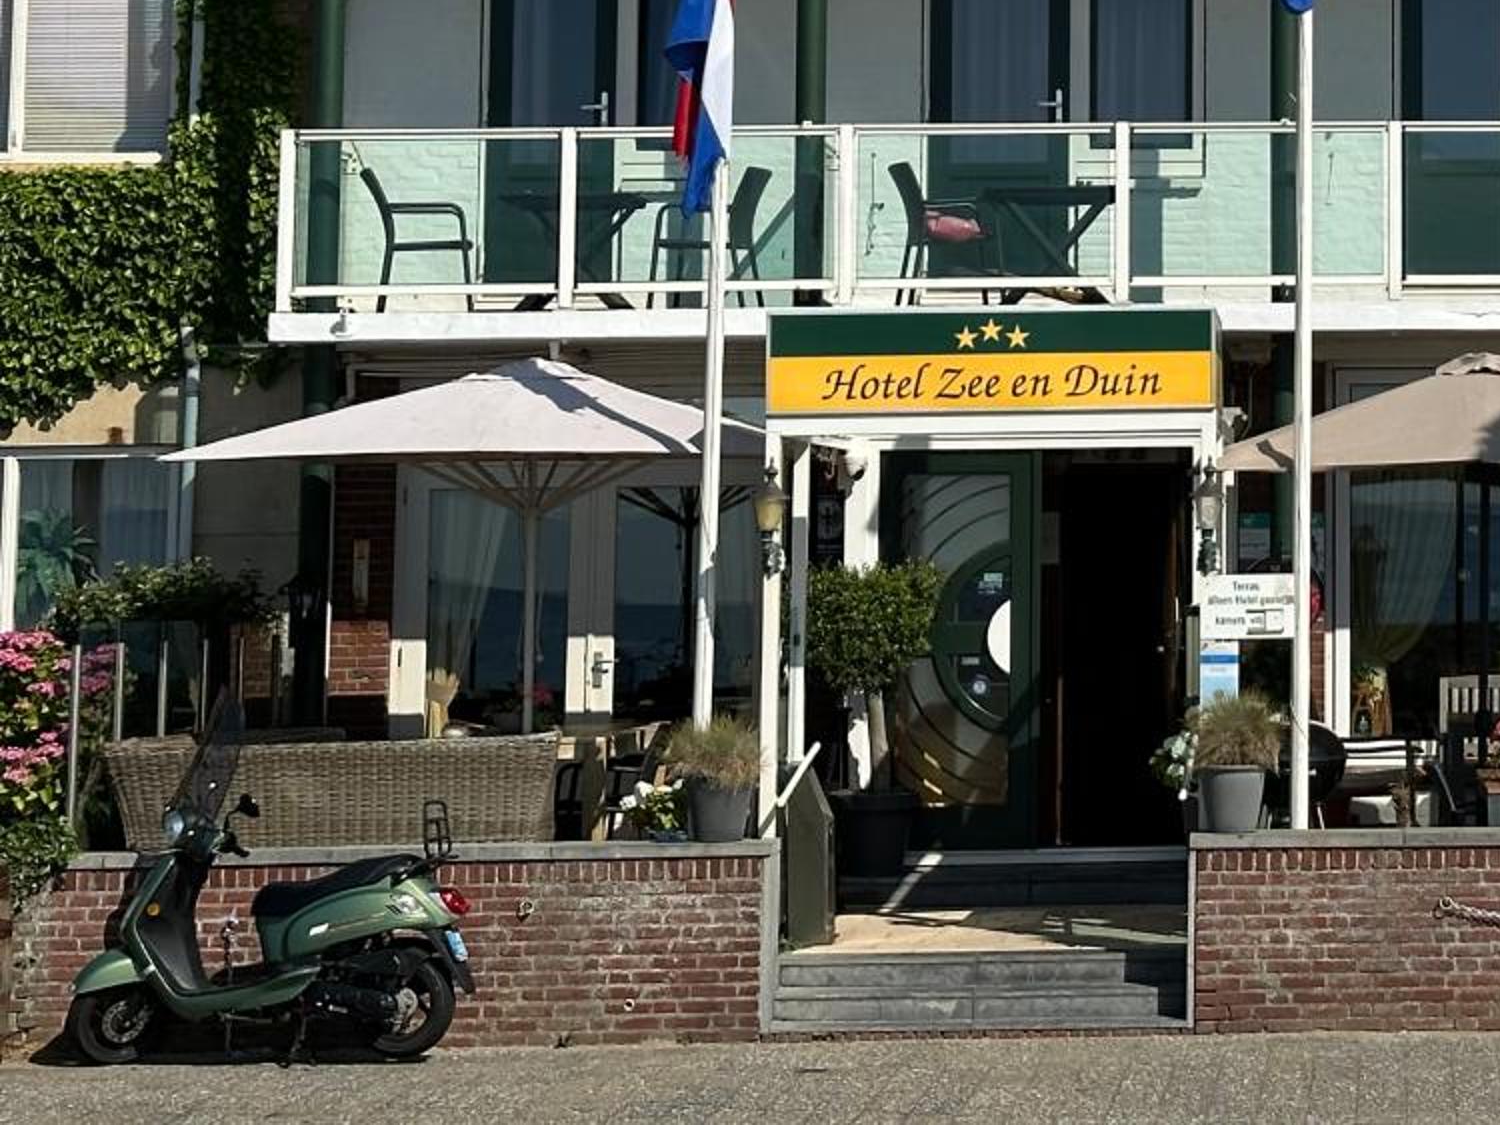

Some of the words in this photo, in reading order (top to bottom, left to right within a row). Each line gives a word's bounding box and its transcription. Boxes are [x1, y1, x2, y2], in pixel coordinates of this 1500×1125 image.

[821, 362, 932, 401] Hotel
[934, 367, 1000, 400] Zee
[1011, 374, 1053, 398] en
[1063, 363, 1163, 397] Duin
